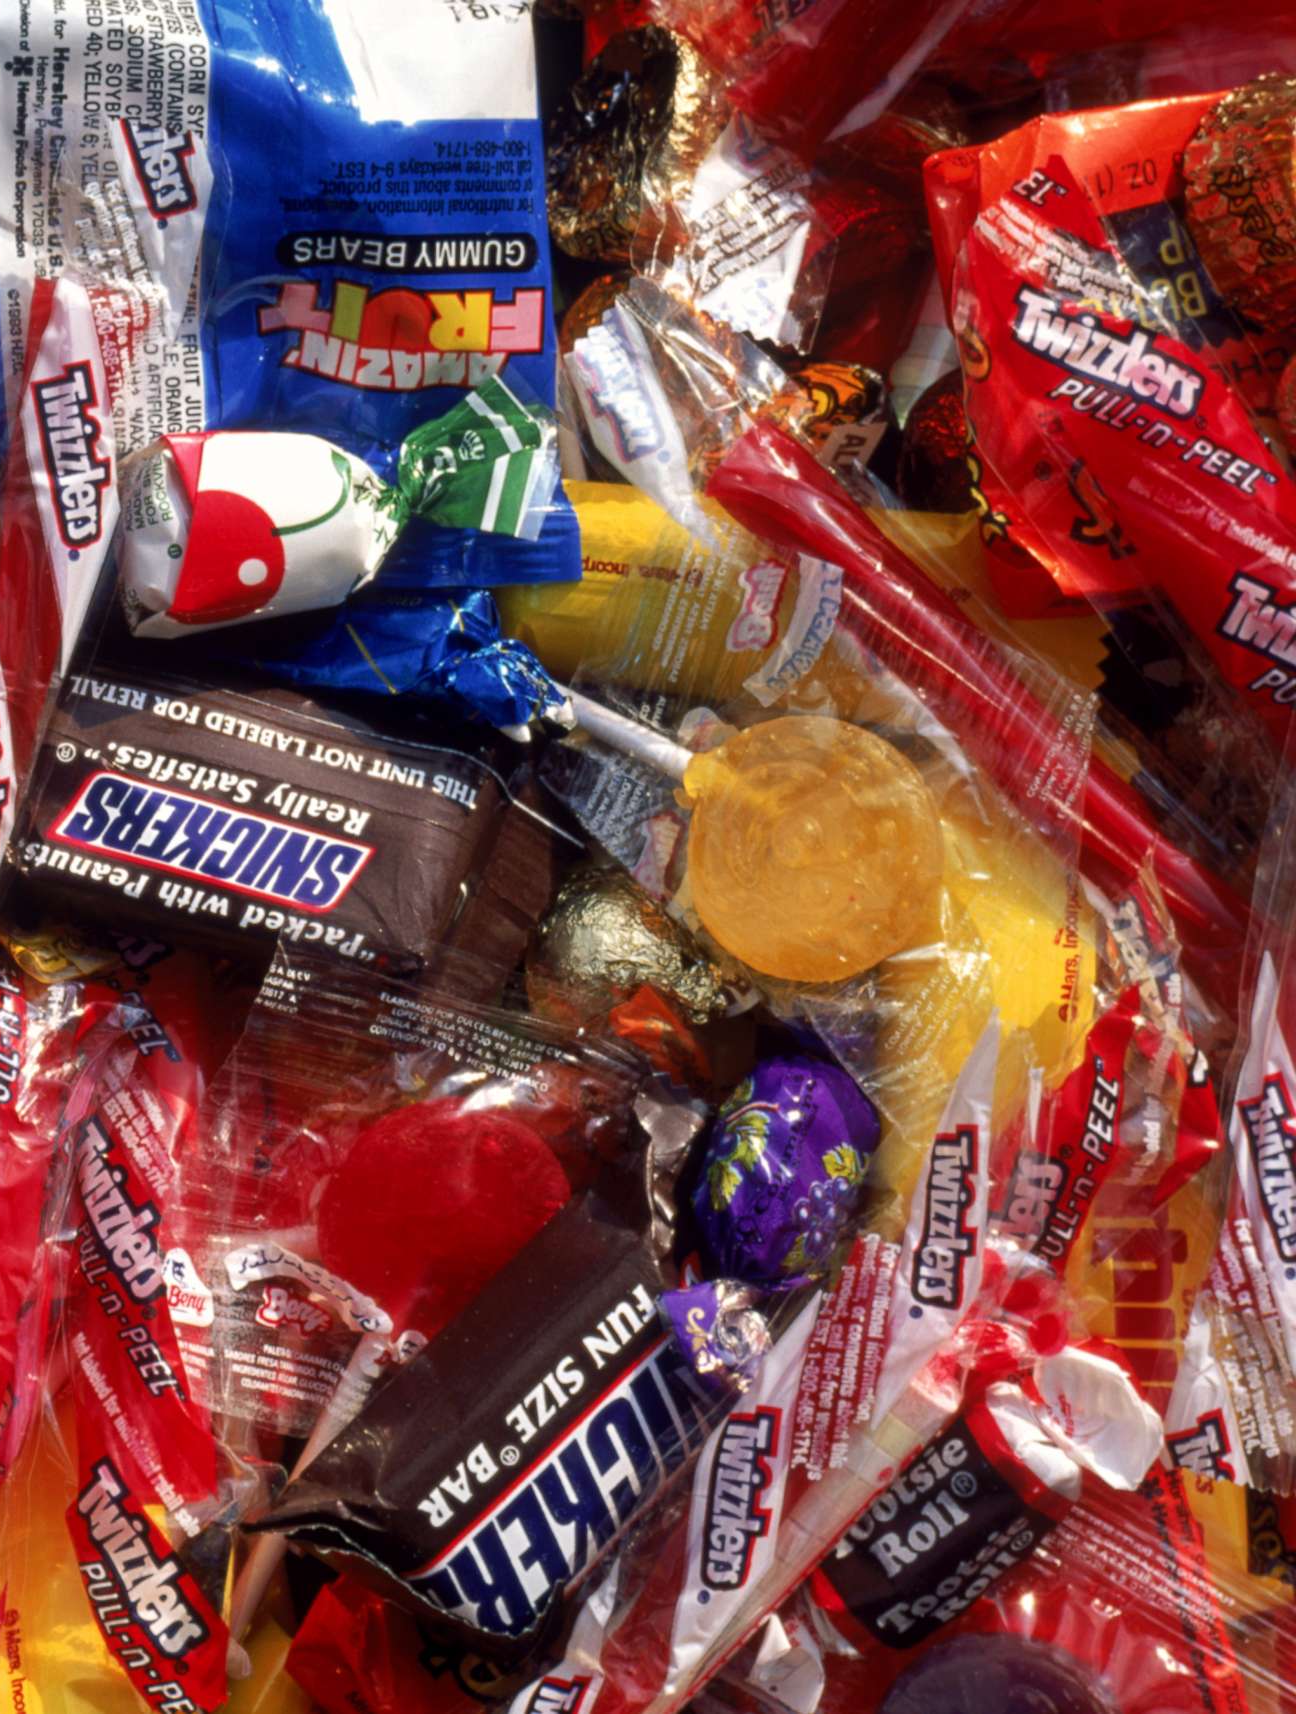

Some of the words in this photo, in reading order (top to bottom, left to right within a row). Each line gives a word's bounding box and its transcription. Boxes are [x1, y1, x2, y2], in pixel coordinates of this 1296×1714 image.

[51, 46, 70, 130] Hershey
[126, 24, 145, 94] SODIUM
[188, 43, 206, 96] CORN
[82, 60, 102, 131] YELLOW
[12, 180, 27, 258] Corporation
[386, 178, 414, 194] this
[416, 179, 455, 194] about
[445, 198, 516, 215] nutritional
[292, 235, 408, 268] BEARS
[413, 238, 527, 268] GUMMY
[259, 281, 545, 353] FRUIT
[181, 333, 202, 388] FRUIT
[1015, 289, 1203, 419] Twizzlers
[146, 363, 165, 440] ARTIFICIA
[164, 376, 184, 434] ORANG
[1049, 376, 1262, 494] PULL-n-PEEL
[41, 371, 101, 542] Twizzlers
[70, 676, 149, 711] RETAIL
[151, 693, 200, 727] FOR
[204, 704, 308, 765] LABELED
[309, 744, 365, 775] NOT
[368, 757, 427, 790] UNIT
[431, 772, 479, 811] THIS
[64, 774, 364, 910] SNICKERS
[263, 790, 372, 836] Really
[157, 874, 230, 917] with
[75, 1119, 163, 1300] Twizzlers
[917, 1133, 972, 1304] Twizzlers
[879, 1241, 903, 1269] For
[167, 1284, 205, 1313] Beny
[582, 1283, 659, 1370] FUN
[867, 1266, 893, 1339] nutritional
[838, 1322, 864, 1400] comments
[853, 1340, 885, 1425] information,
[506, 1355, 586, 1445] SIZE
[417, 1442, 499, 1529] BAR
[706, 1413, 776, 1587] Twizzlers
[77, 1464, 206, 1658] Twizzlers
[869, 1489, 972, 1580] Roll
